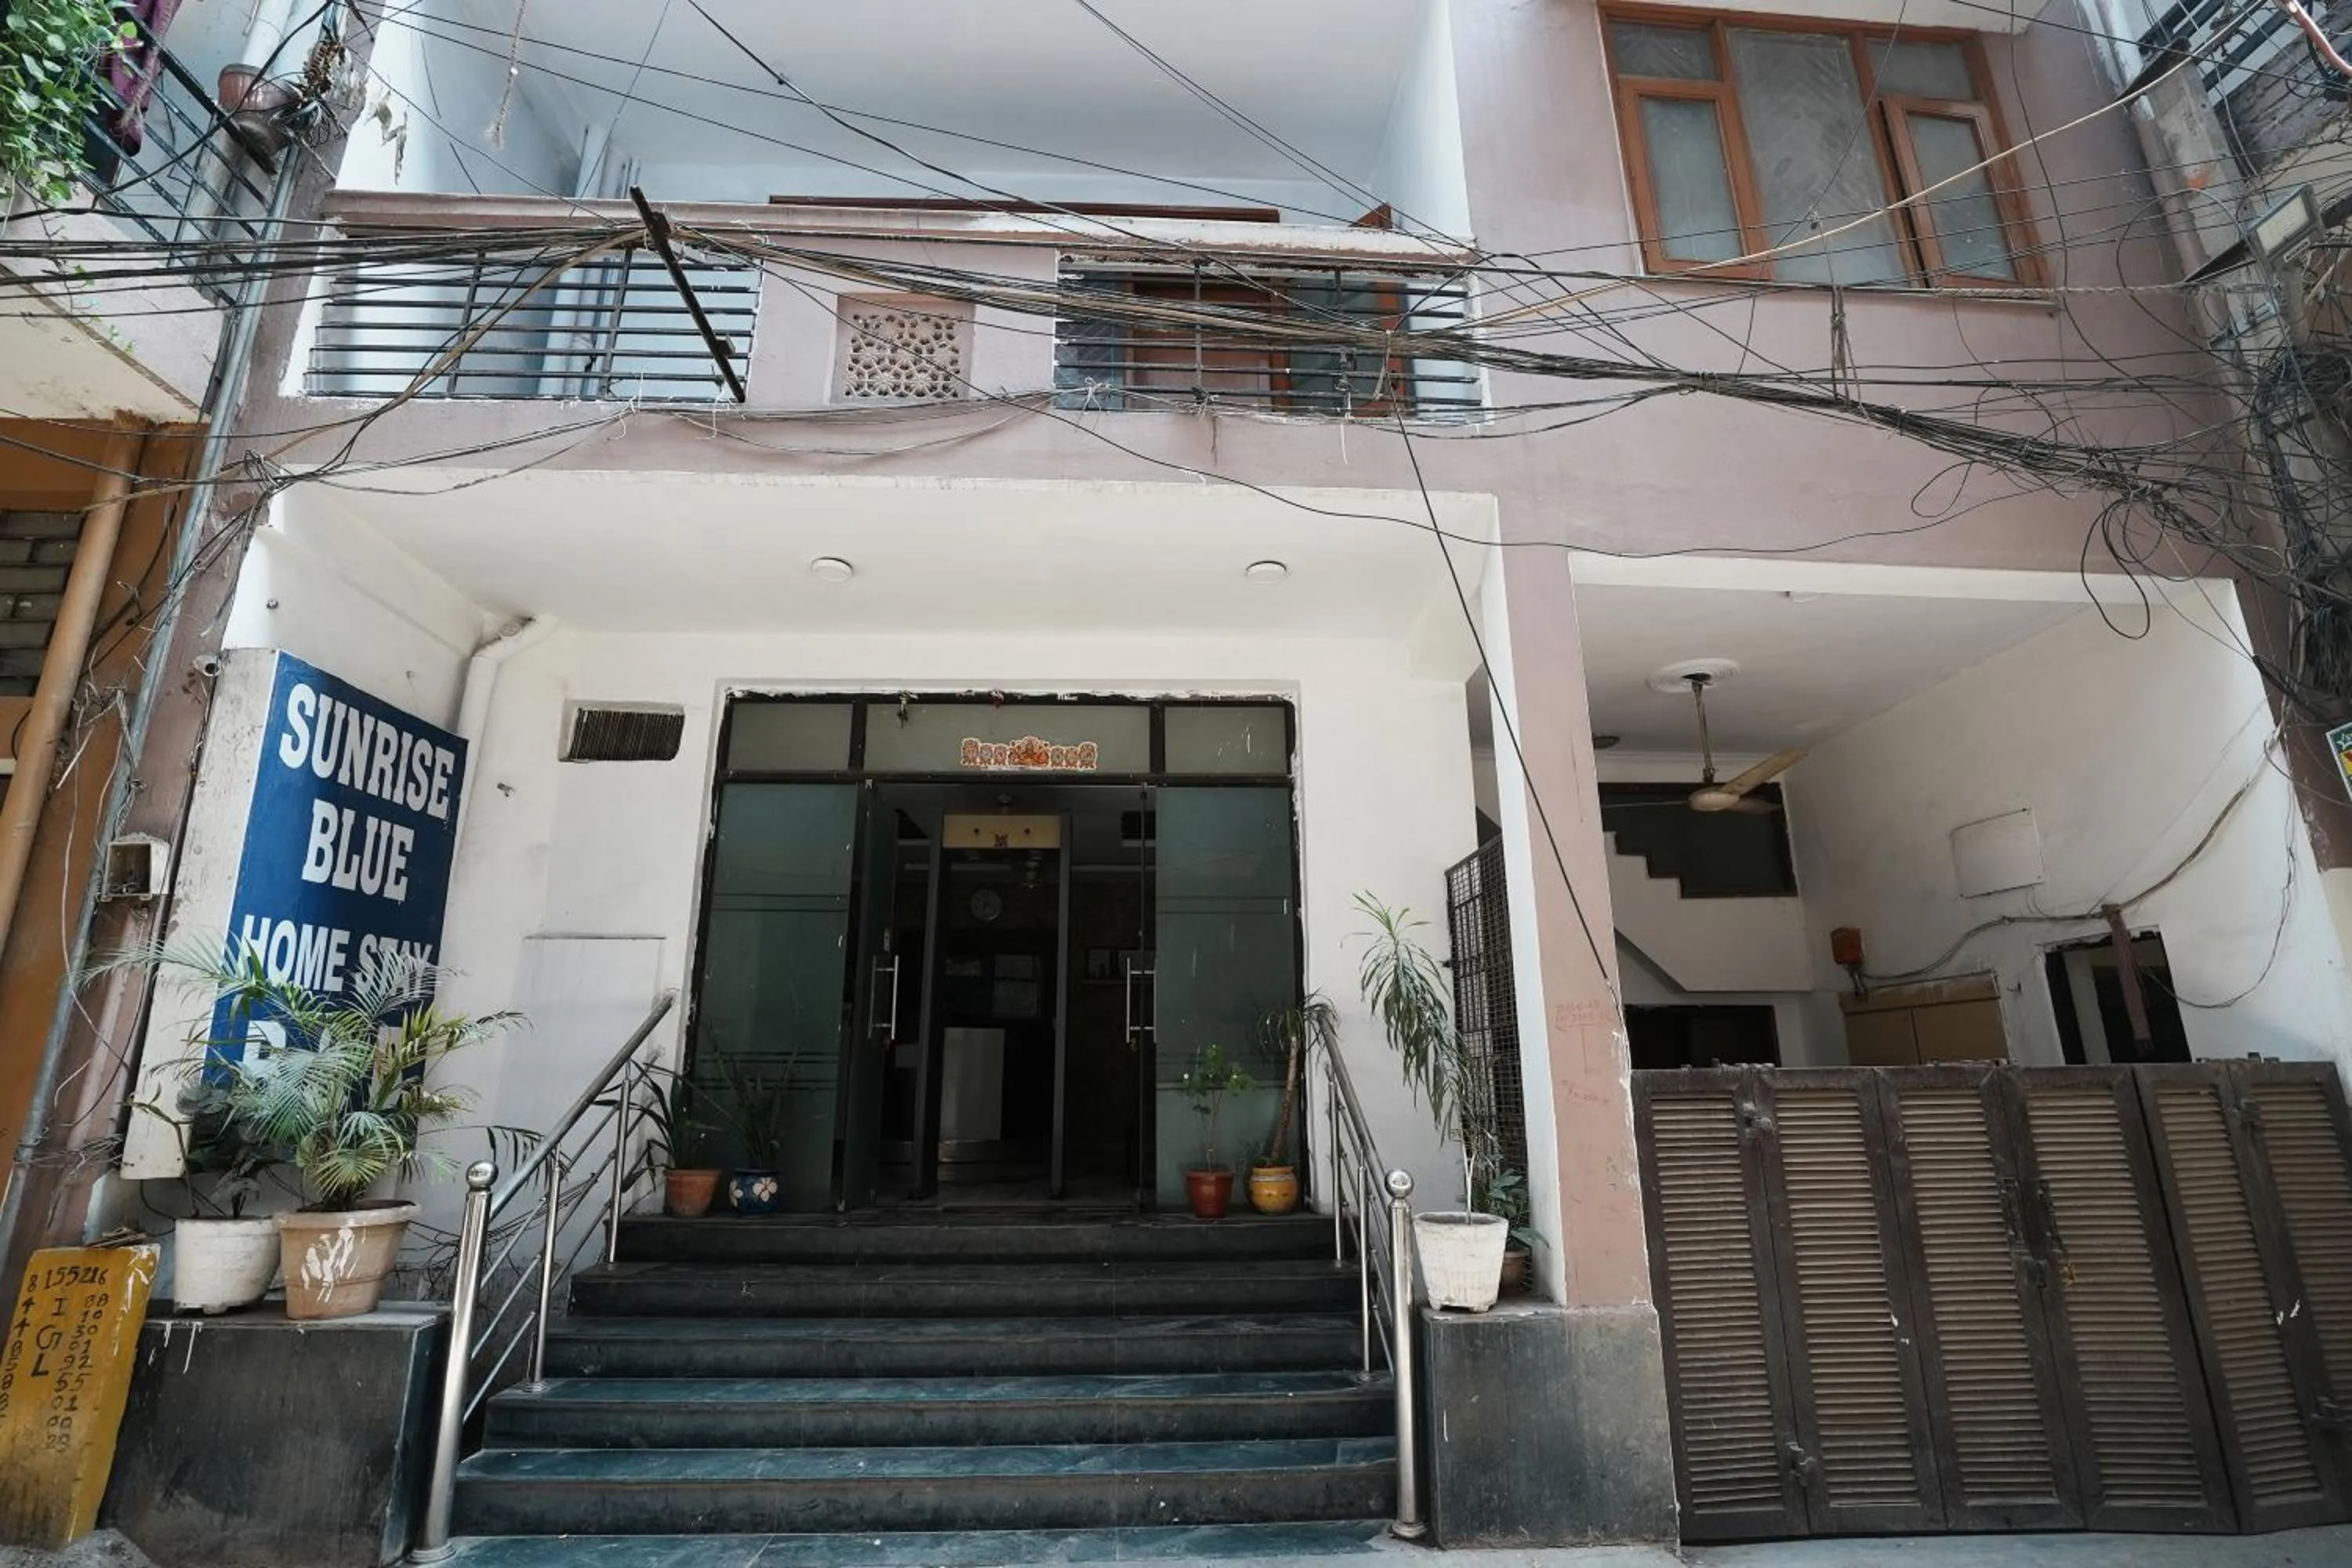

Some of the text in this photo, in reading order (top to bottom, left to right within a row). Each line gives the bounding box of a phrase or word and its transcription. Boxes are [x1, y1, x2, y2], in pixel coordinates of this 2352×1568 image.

[278, 683, 455, 819] SUNRISE
[302, 798, 415, 902] BLUE
[238, 914, 350, 993] HOME
